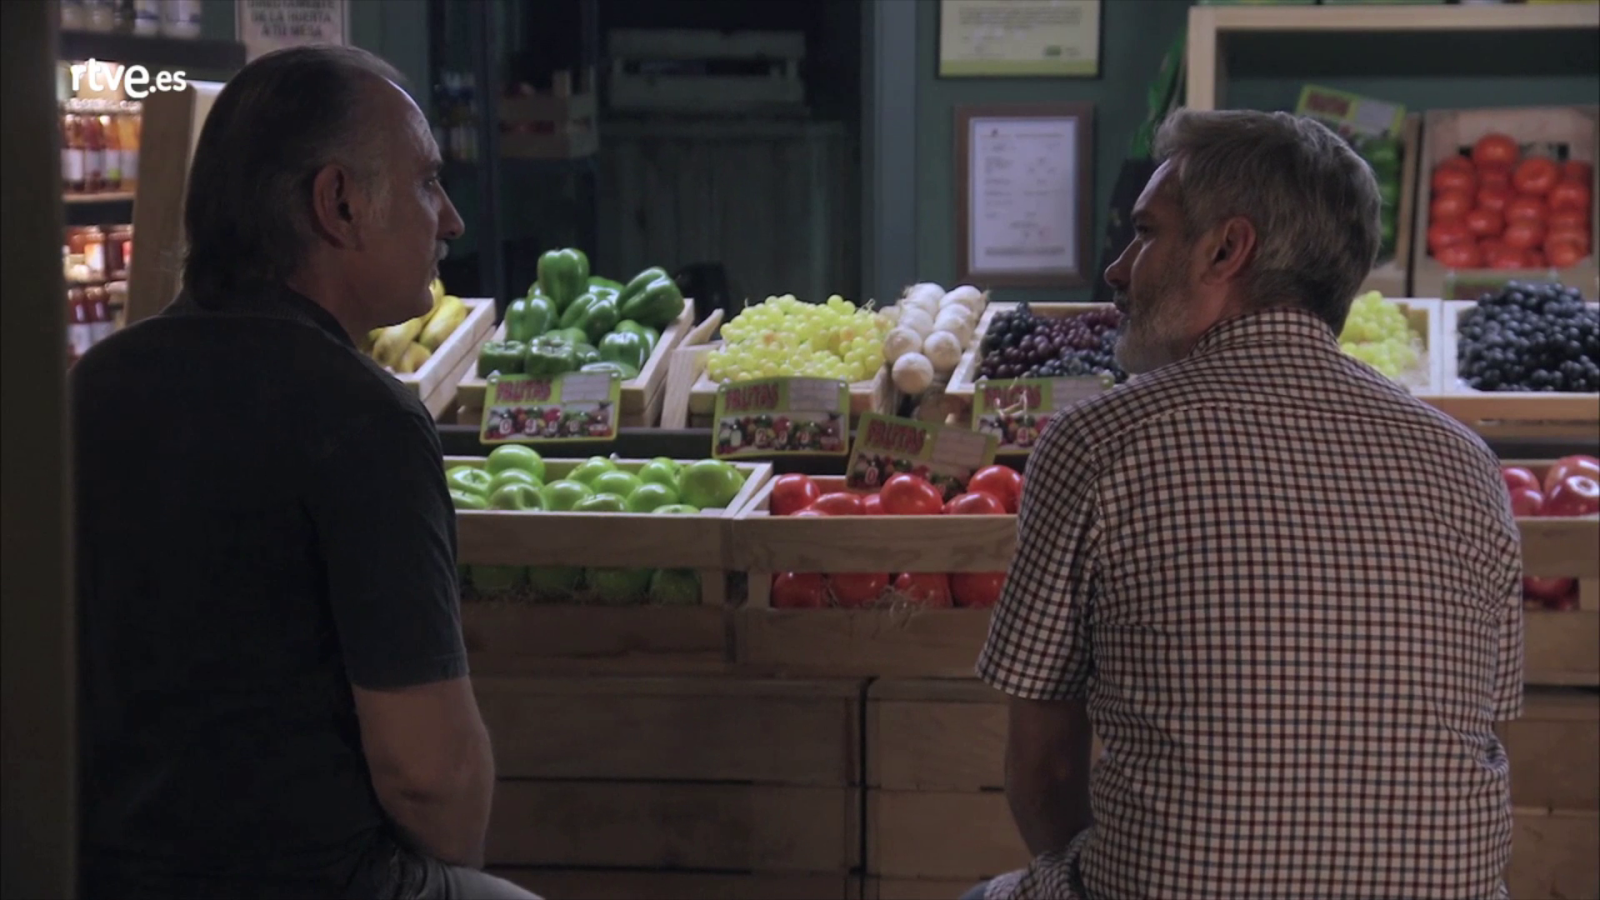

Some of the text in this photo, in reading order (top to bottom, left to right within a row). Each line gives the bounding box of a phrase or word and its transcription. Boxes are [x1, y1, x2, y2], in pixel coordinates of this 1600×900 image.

[270, 11, 284, 22] LA
[288, 11, 331, 22] HUERTA
[290, 25, 322, 36] MESA
[496, 379, 551, 402] FRUTAS
[725, 383, 779, 412] FRUTAS
[864, 418, 927, 456] FRUTAS
